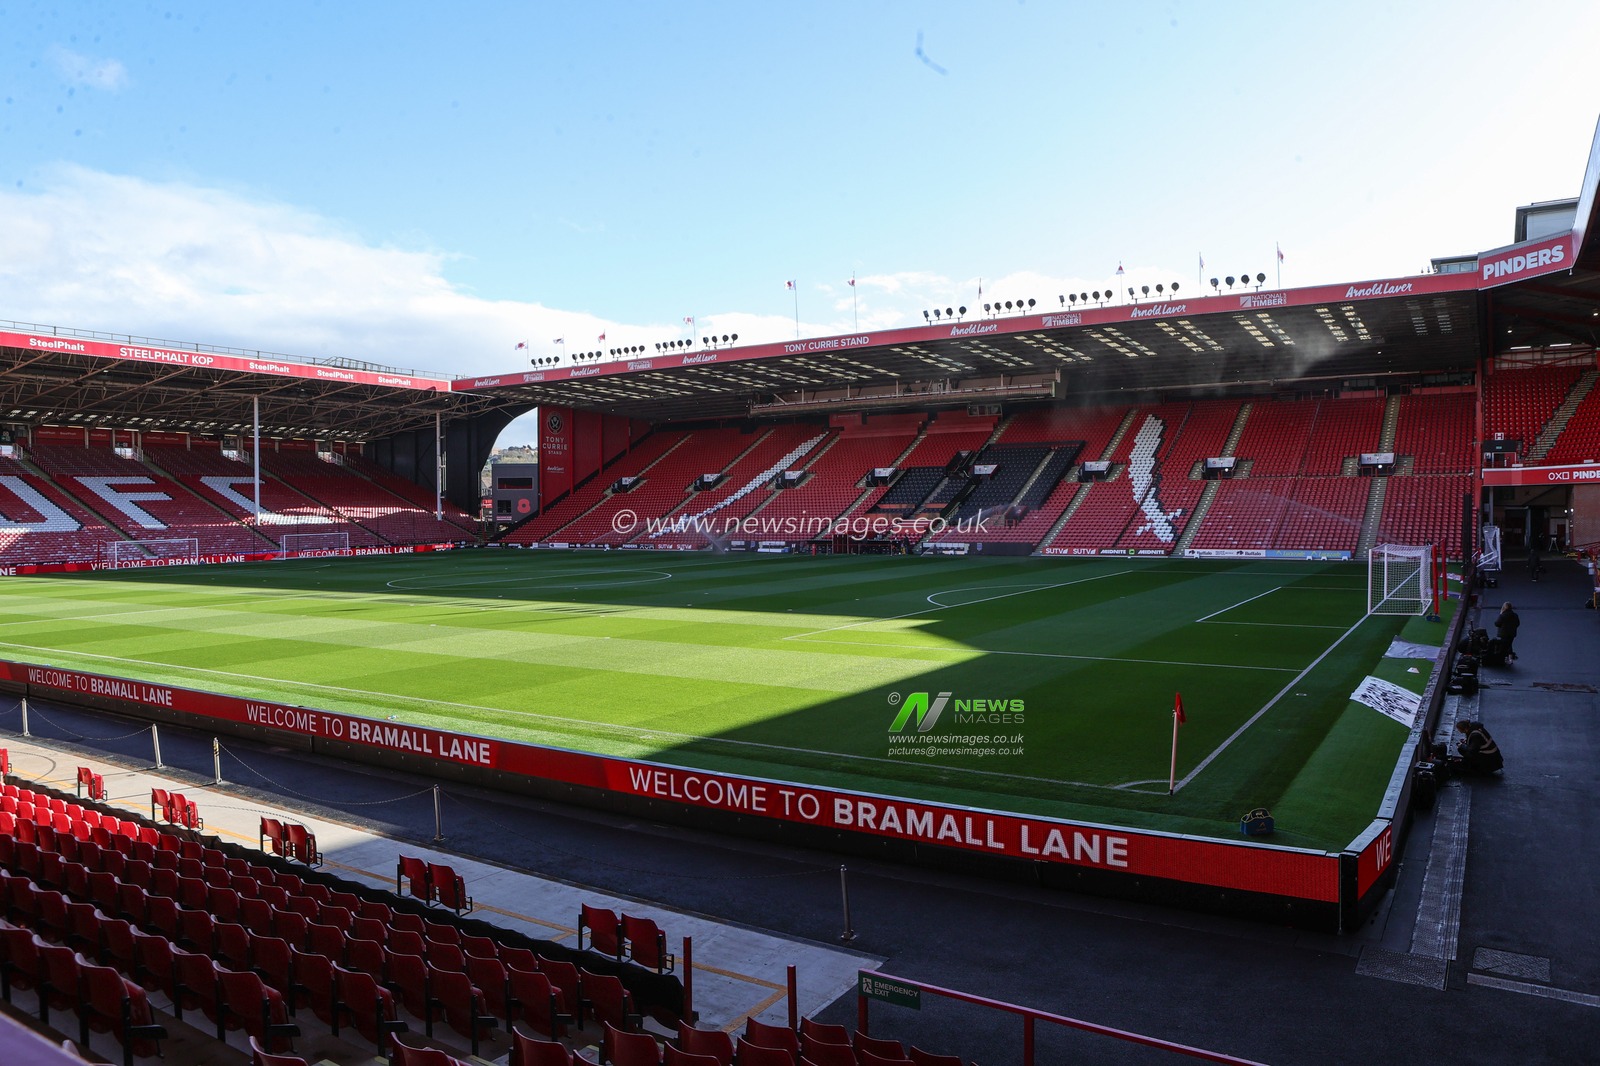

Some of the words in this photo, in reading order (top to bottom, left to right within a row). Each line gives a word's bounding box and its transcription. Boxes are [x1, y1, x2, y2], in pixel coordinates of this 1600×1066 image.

[1483, 245, 1565, 281] PINDERS
[1346, 283, 1381, 298] Arnold
[1383, 281, 1413, 294] Laver
[1252, 298, 1283, 307] TIMBER
[1131, 306, 1159, 318] Arnold
[1161, 304, 1186, 315] Laver
[1053, 318, 1079, 326] TIMBER
[950, 325, 976, 336] Arnold
[977, 323, 997, 333] Laver
[29, 338, 85, 351] SteelPhalt
[784, 344, 807, 353] TONY
[809, 339, 839, 350] CURRIE
[840, 336, 870, 346] STAND
[119, 347, 189, 365] STEELPHALT
[191, 354, 214, 366] KOP
[249, 361, 290, 373] SteelPhalt
[317, 369, 354, 381] SteelPhalt
[378, 376, 411, 387] SteelPhalt
[355, 548, 392, 556] BRAMALL
[394, 546, 414, 554] LANE
[150, 559, 165, 567] TO
[220, 555, 245, 563] LANE
[28, 668, 72, 688] WELCOME
[75, 676, 88, 691] TO
[91, 679, 139, 701] BRAMALL
[142, 686, 172, 706] LANE
[246, 703, 317, 733] WELCOME
[322, 716, 343, 737] TO
[350, 721, 432, 754] BRAMALL
[439, 735, 490, 764] LANE
[629, 767, 767, 812] WELCOME
[779, 789, 820, 820] TO
[834, 797, 1005, 849] BRAMALL
[1021, 824, 1128, 868] LANE
[874, 981, 919, 997] EMERGENCY
[874, 988, 890, 997] EXIT
